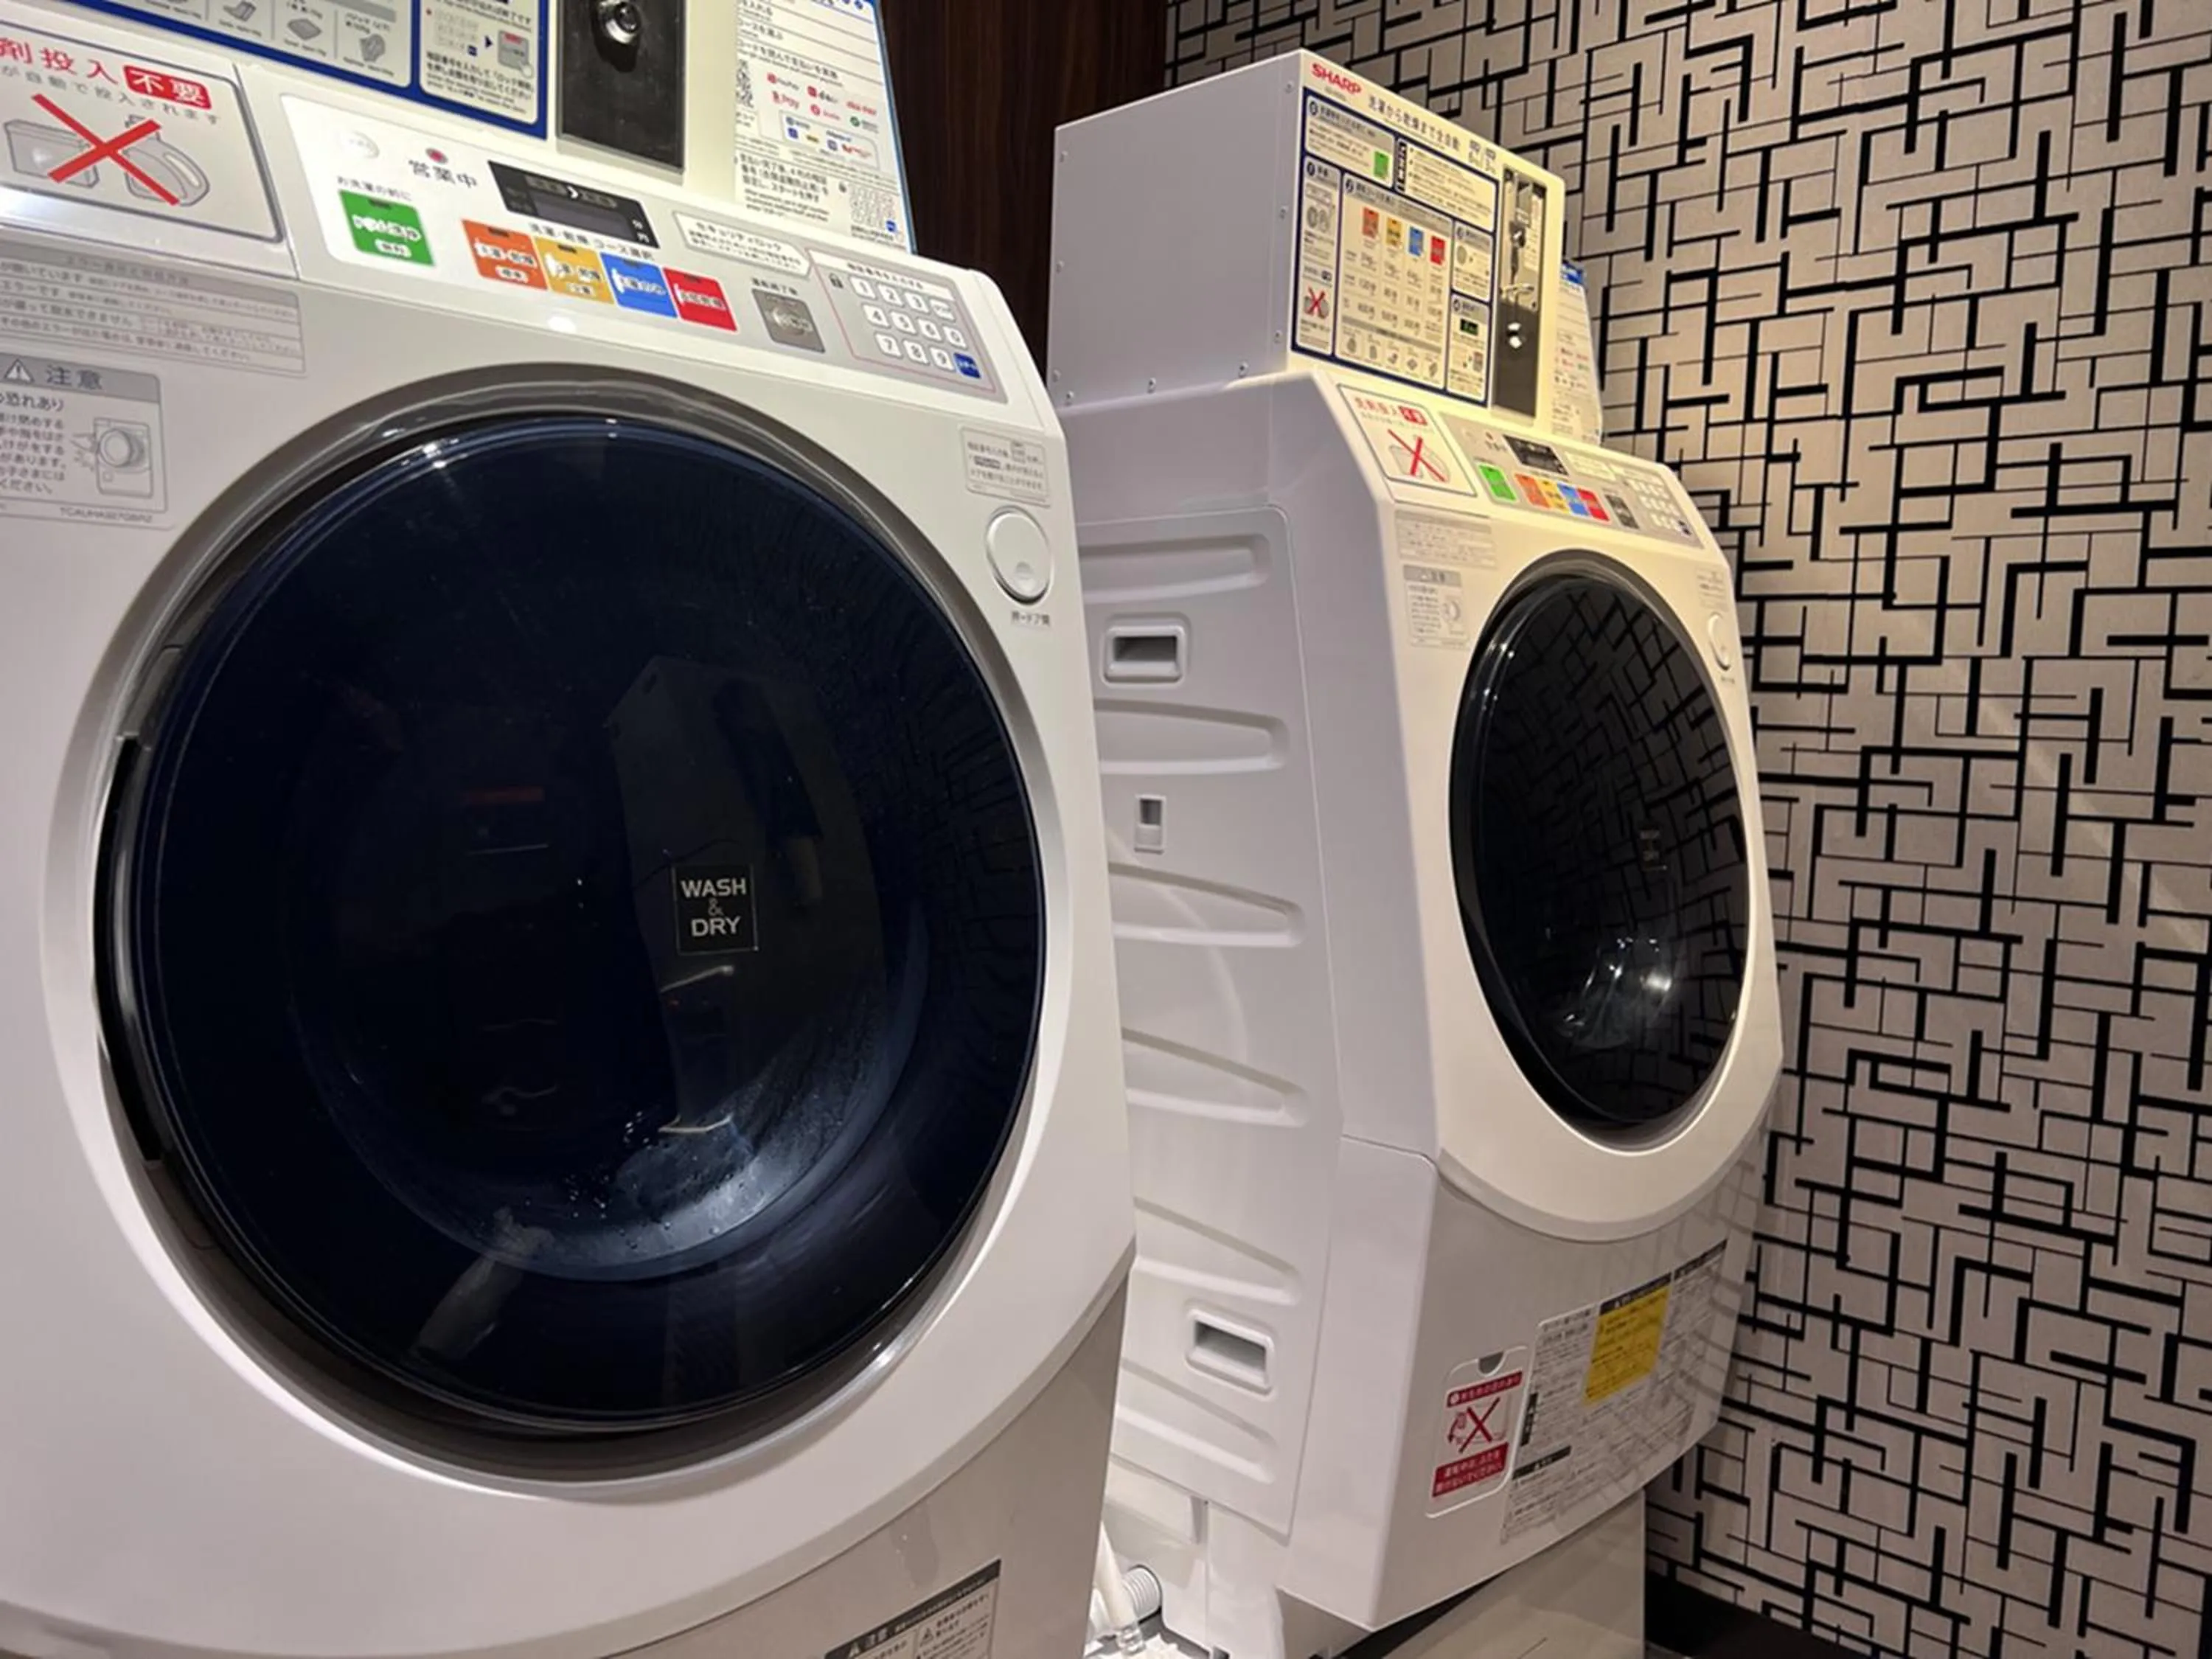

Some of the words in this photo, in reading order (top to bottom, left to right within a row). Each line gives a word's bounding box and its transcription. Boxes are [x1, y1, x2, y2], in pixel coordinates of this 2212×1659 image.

[0, 36, 119, 86] 剤投入
[134, 73, 205, 106] 不要
[1312, 63, 1362, 94] SHARP
[408, 159, 478, 189] 営業中
[46, 364, 102, 389] 注意
[681, 877, 746, 898] WASH
[708, 897, 724, 916] &
[691, 916, 741, 936] DRY
